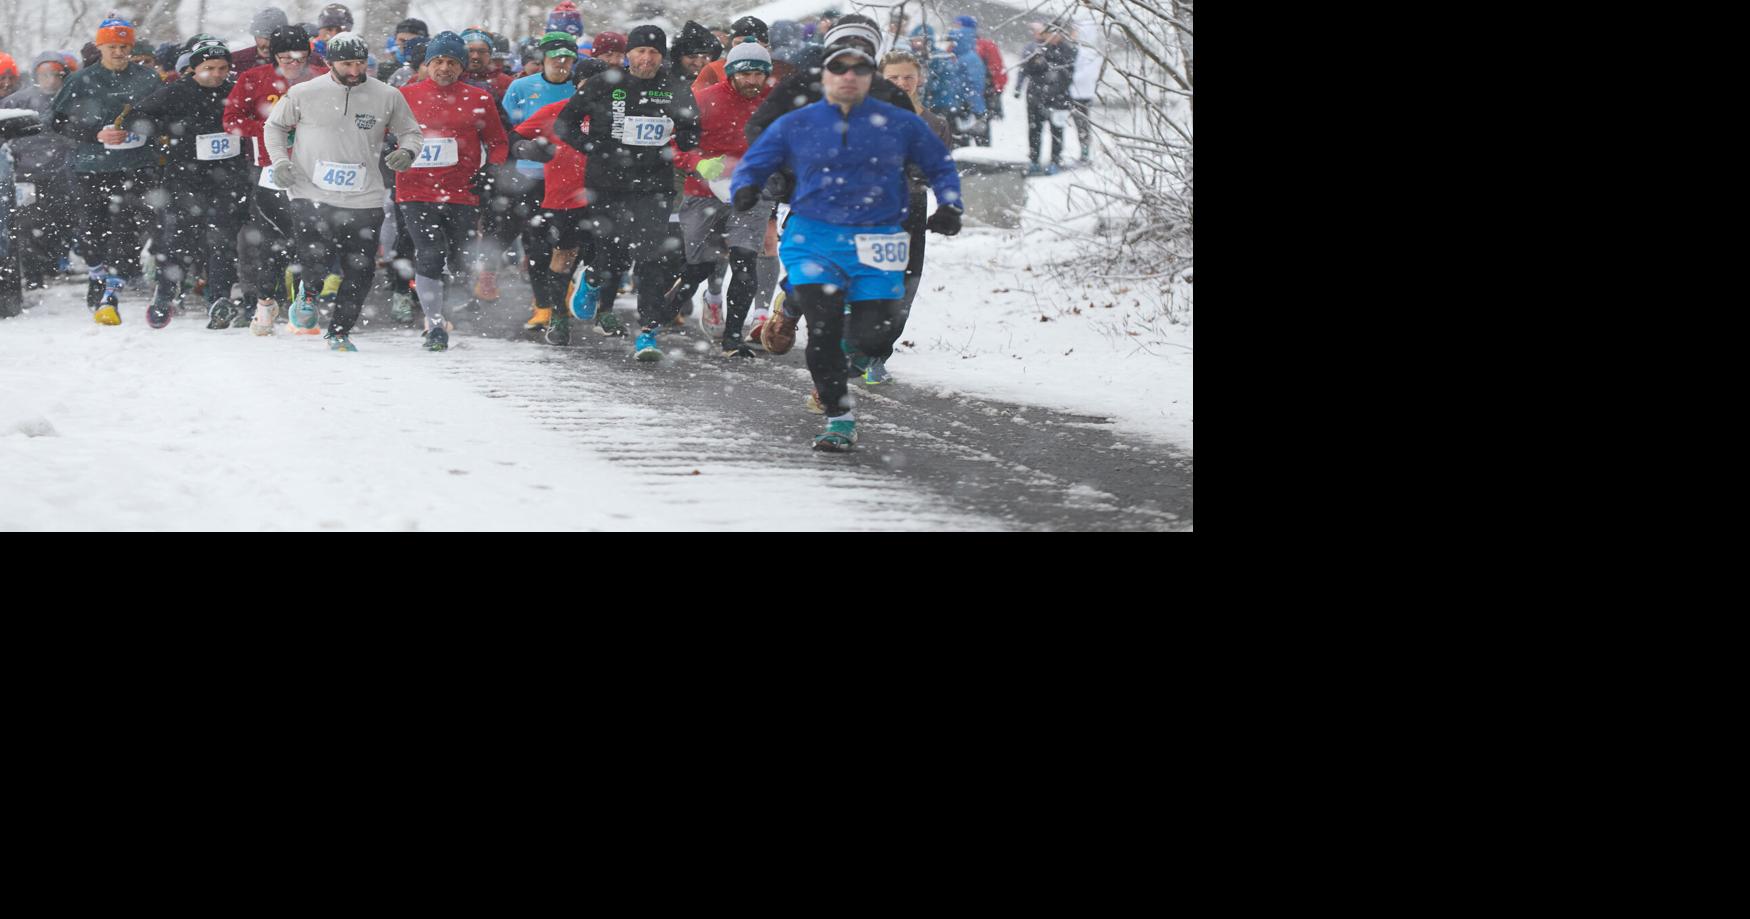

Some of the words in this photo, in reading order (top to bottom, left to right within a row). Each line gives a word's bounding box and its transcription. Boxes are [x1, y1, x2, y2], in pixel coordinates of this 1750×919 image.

[611, 101, 626, 139] SPARTAN
[635, 123, 665, 140] 129
[211, 138, 230, 154] 98
[323, 168, 357, 186] 462
[871, 241, 907, 263] 380
